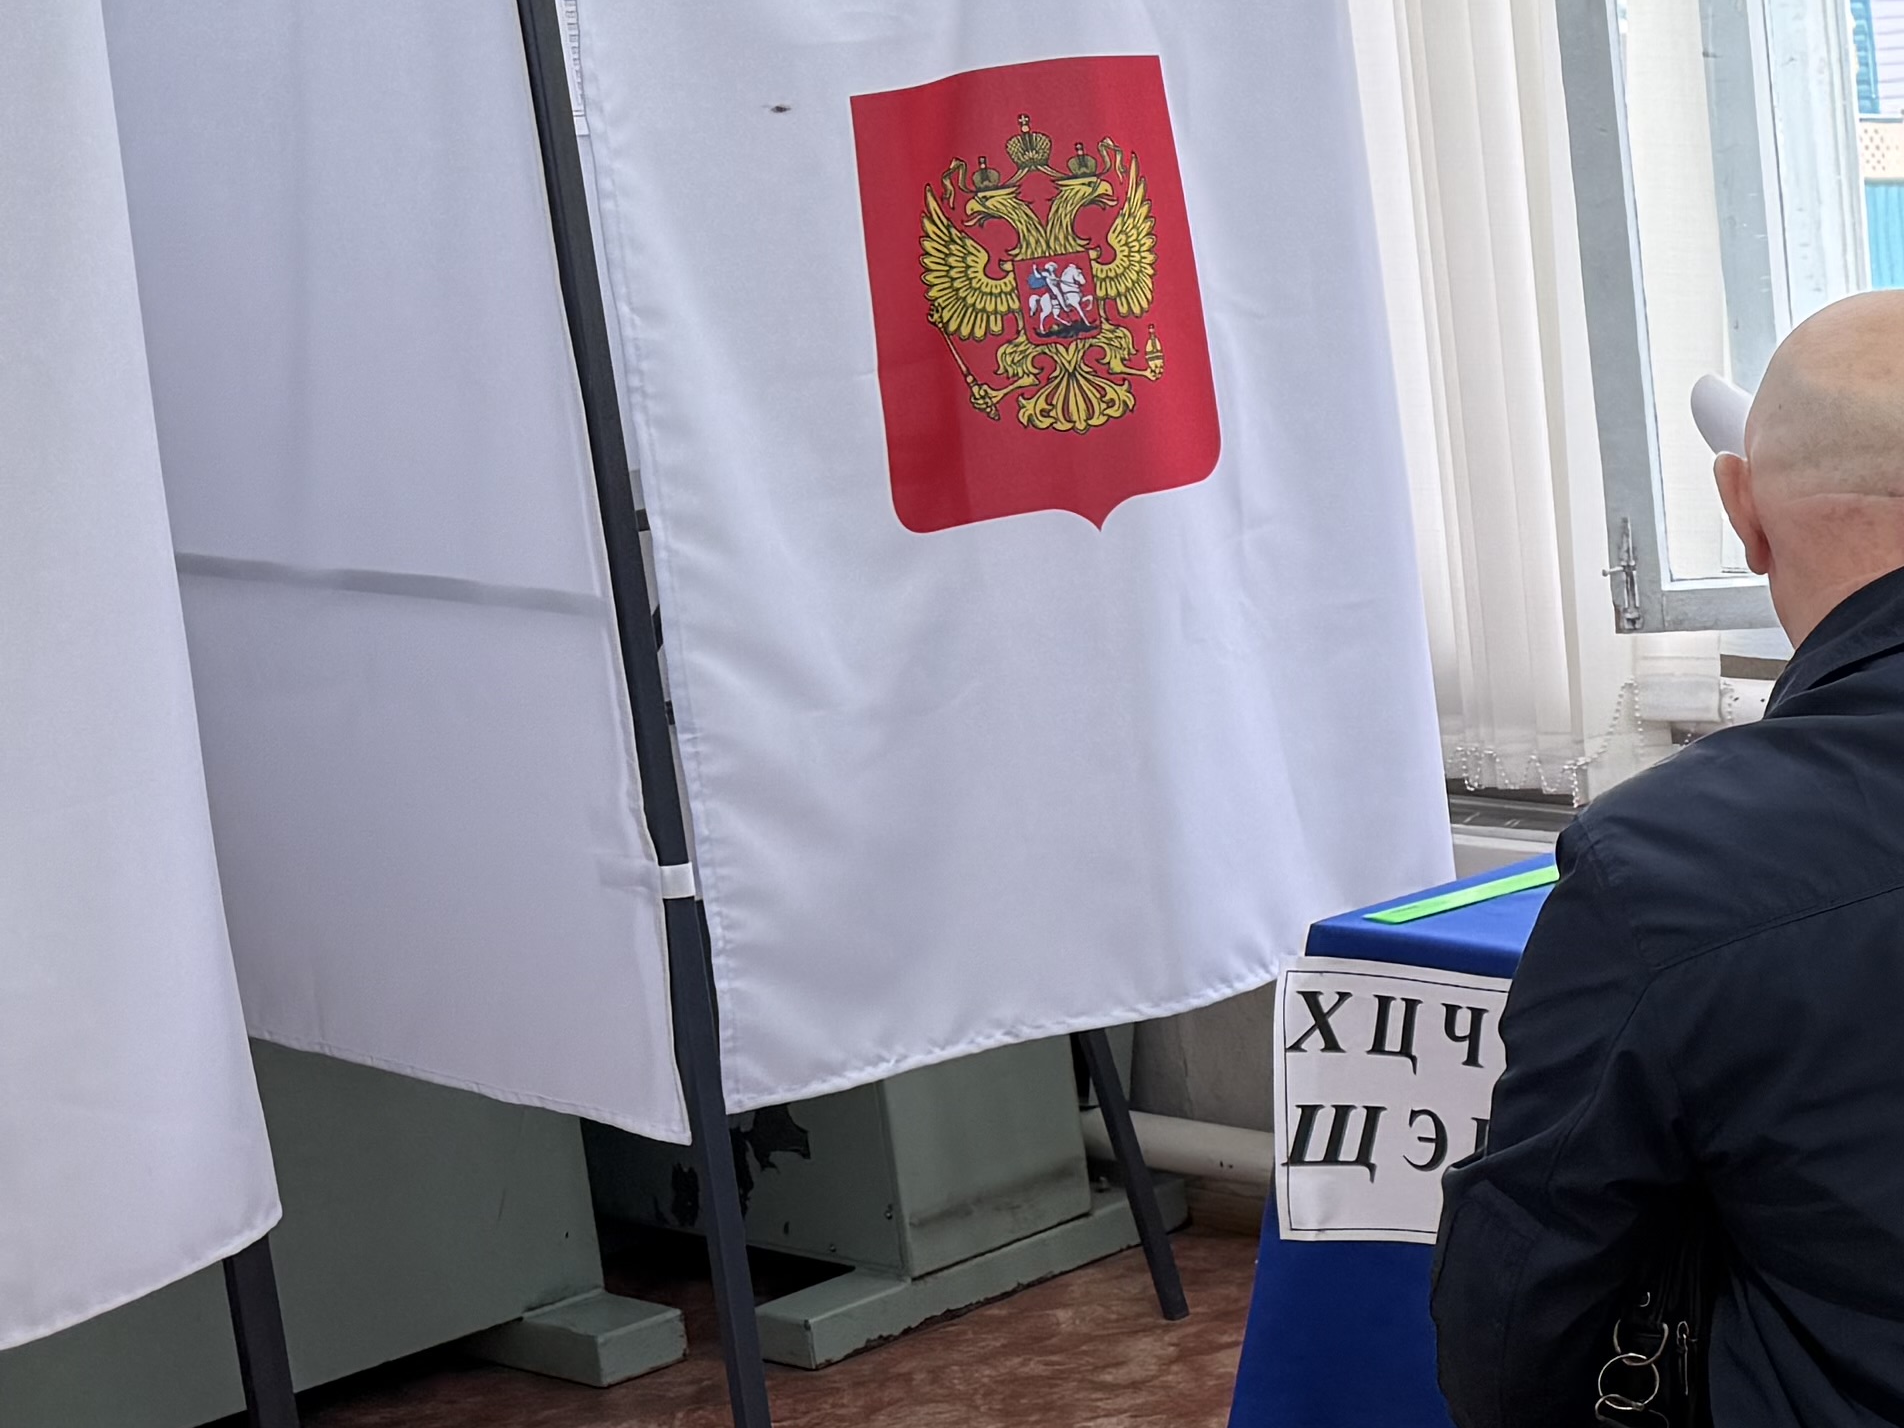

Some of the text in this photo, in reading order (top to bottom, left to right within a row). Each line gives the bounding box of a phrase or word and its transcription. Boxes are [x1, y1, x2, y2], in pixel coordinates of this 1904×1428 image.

[1286, 990, 1490, 1076] Х Ц Ч
[1281, 1104, 1389, 1183] Щ
[1403, 1109, 1448, 1172] Э
